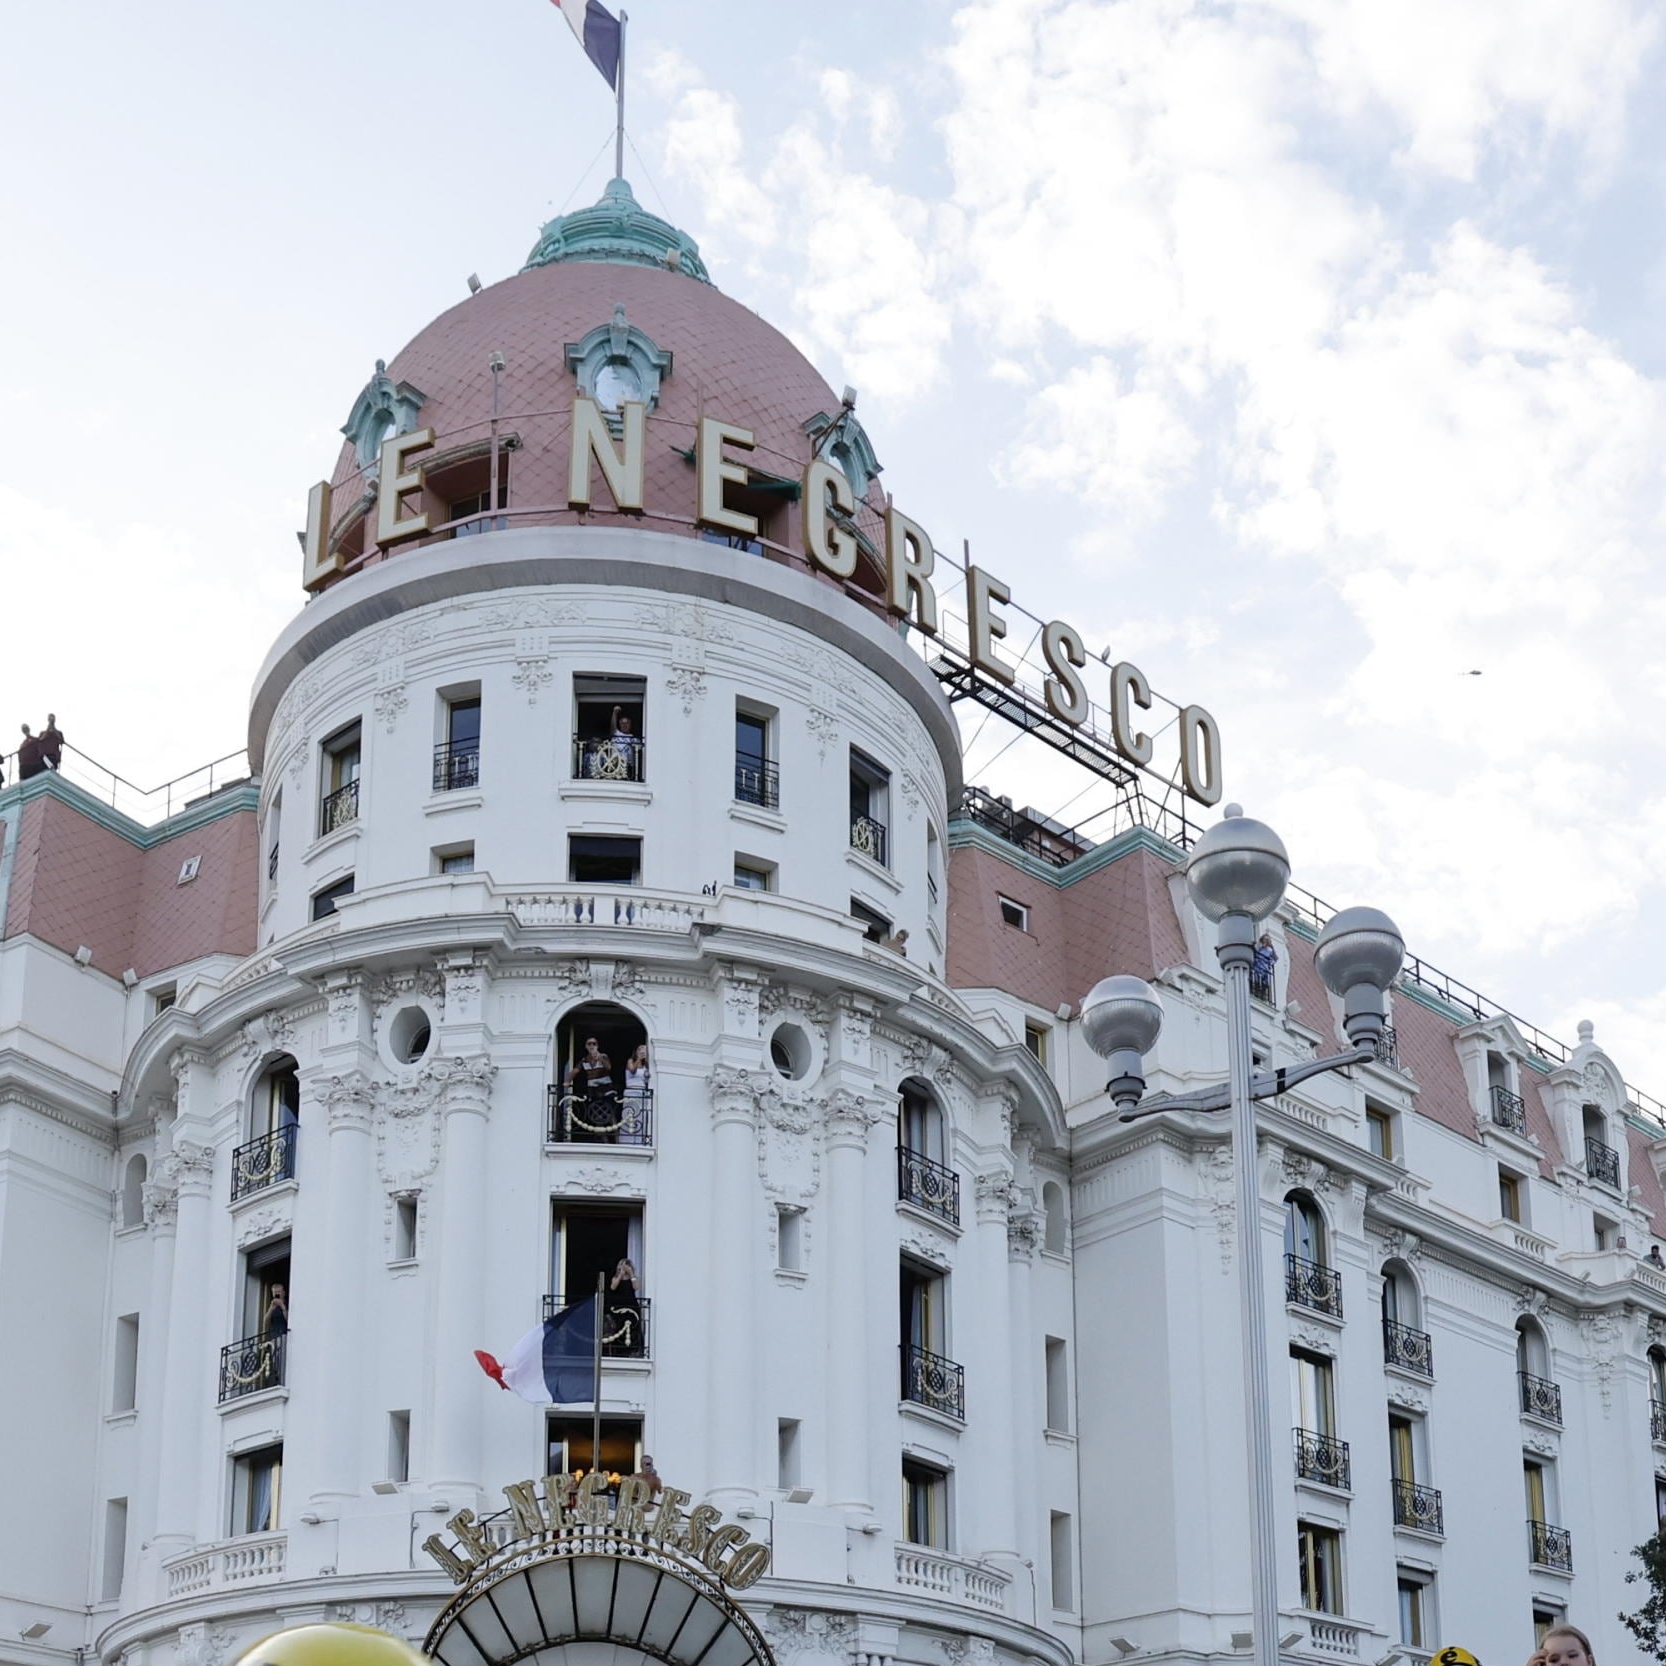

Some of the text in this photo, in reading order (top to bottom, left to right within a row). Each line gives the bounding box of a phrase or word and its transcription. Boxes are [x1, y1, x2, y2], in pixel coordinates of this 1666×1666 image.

[302, 399, 1224, 806] LE NEGRESCO
[422, 1472, 772, 1591] LE NEGRESCO
